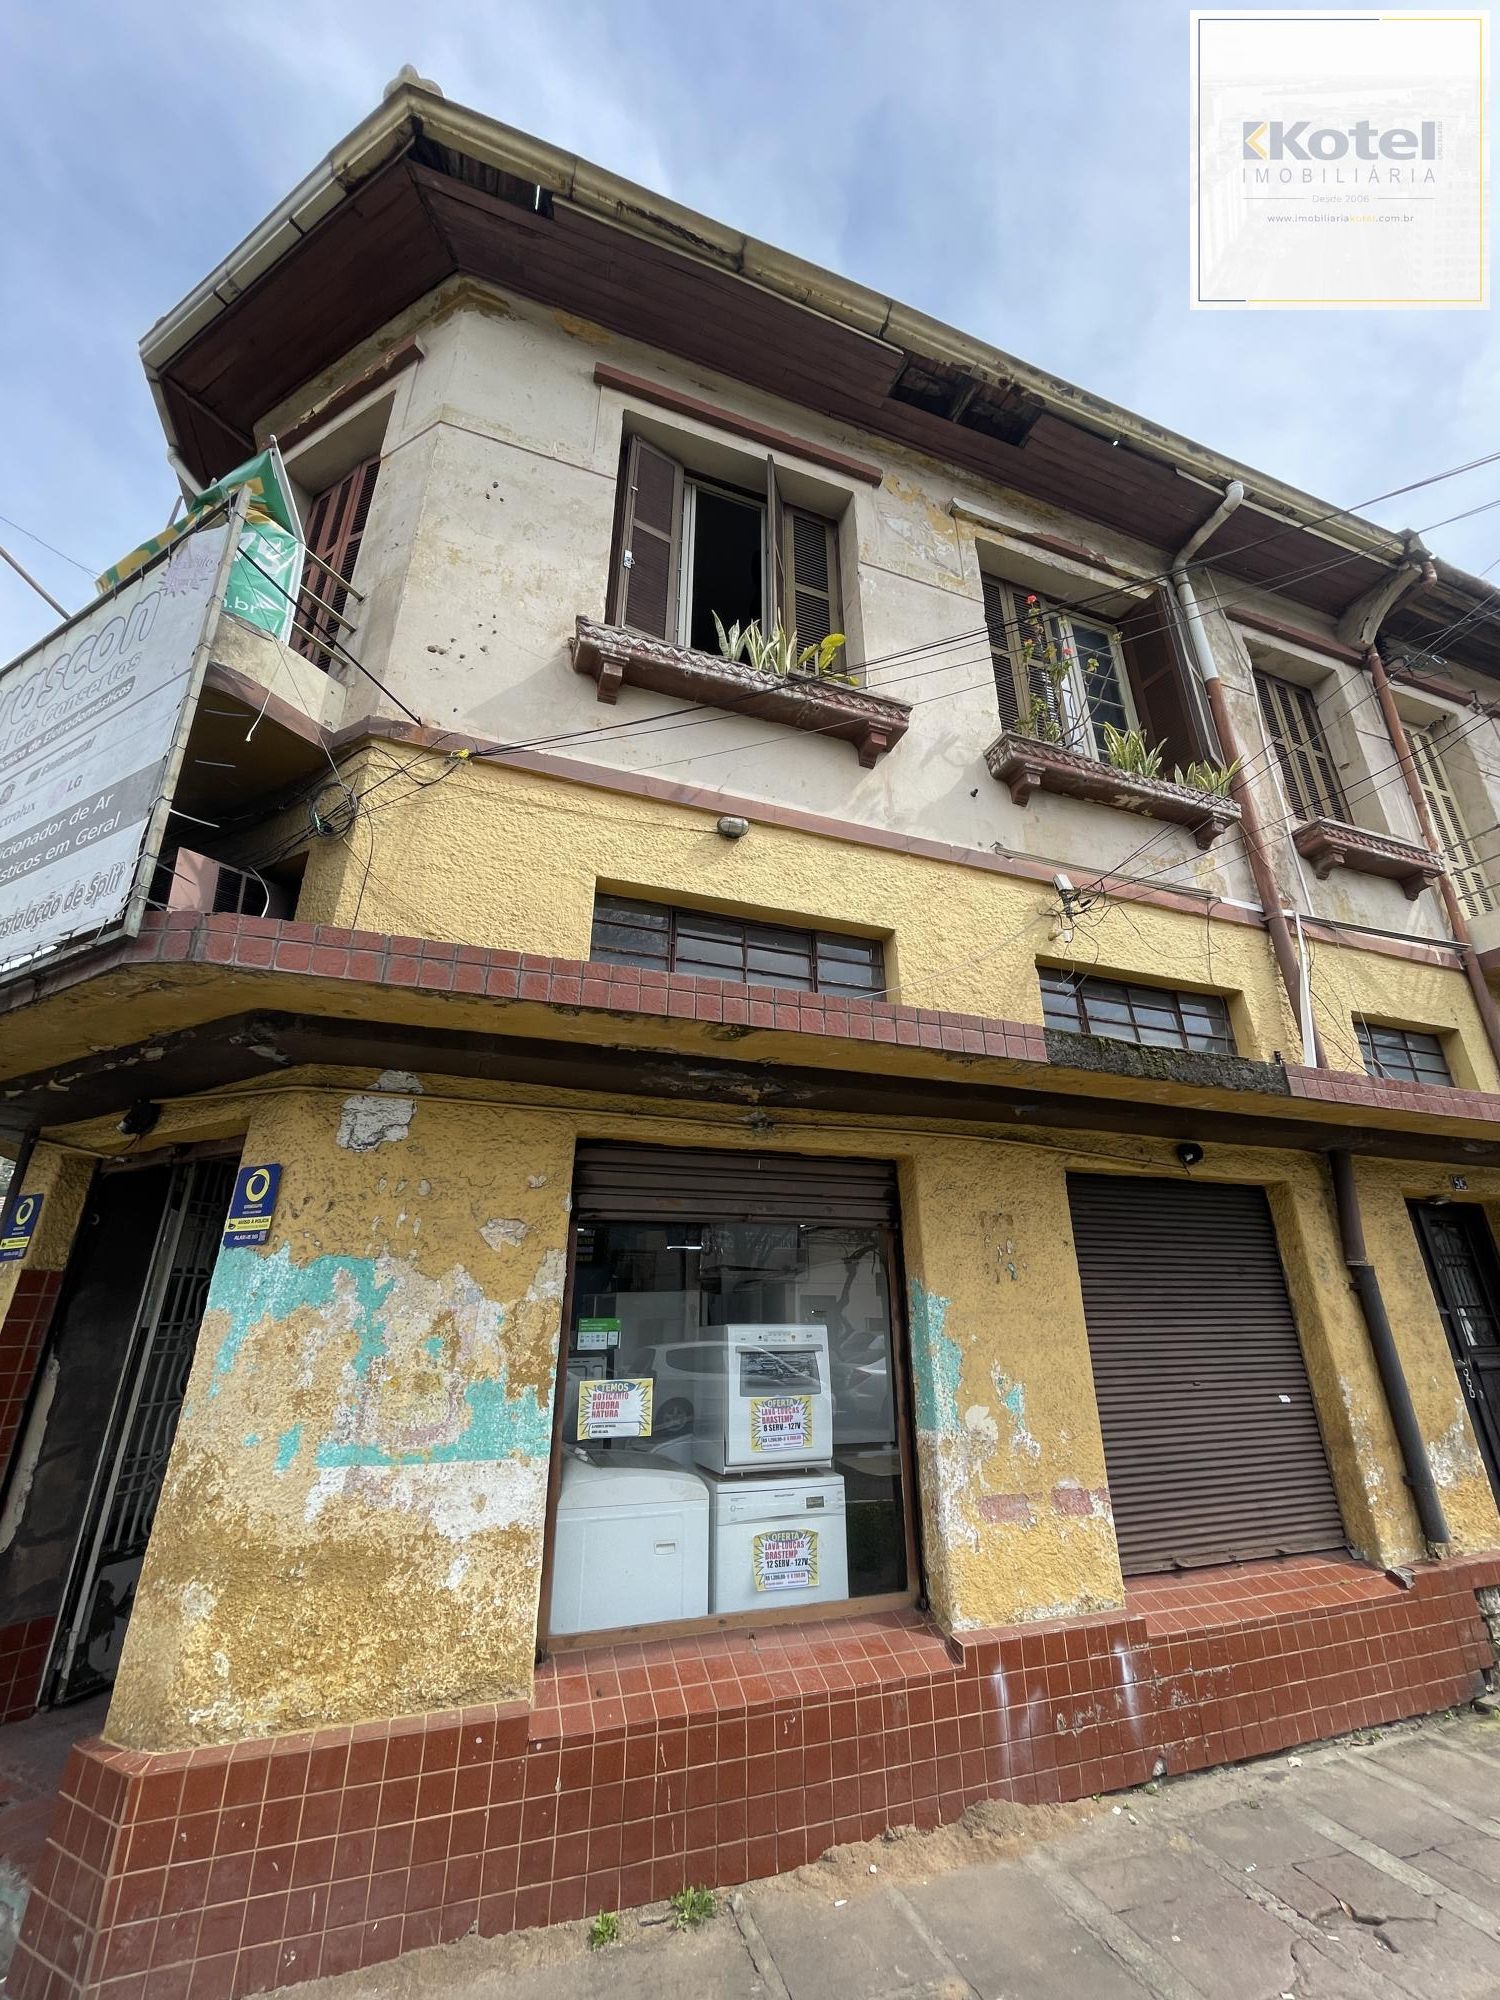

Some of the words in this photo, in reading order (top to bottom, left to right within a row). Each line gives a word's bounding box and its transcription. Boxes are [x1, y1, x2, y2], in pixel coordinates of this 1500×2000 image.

[0, 591, 161, 730] rascon
[67, 774, 84, 793] LG
[69, 807, 90, 826] de
[93, 793, 114, 814] Ar
[45, 841, 71, 860] em
[75, 811, 121, 846] Geral
[62, 880, 86, 913] de
[84, 861, 126, 909] Split
[602, 1382, 629, 1393] TEMOS
[592, 1401, 620, 1410] EUDORA
[767, 1399, 795, 1408] OFERTA
[591, 1410, 619, 1419] NATURA
[762, 1415, 794, 1424] BRASTEMP
[771, 1531, 800, 1541] OFERTA
[765, 1549, 798, 1561] BRASTEMP
[766, 1560, 773, 1569] 12
